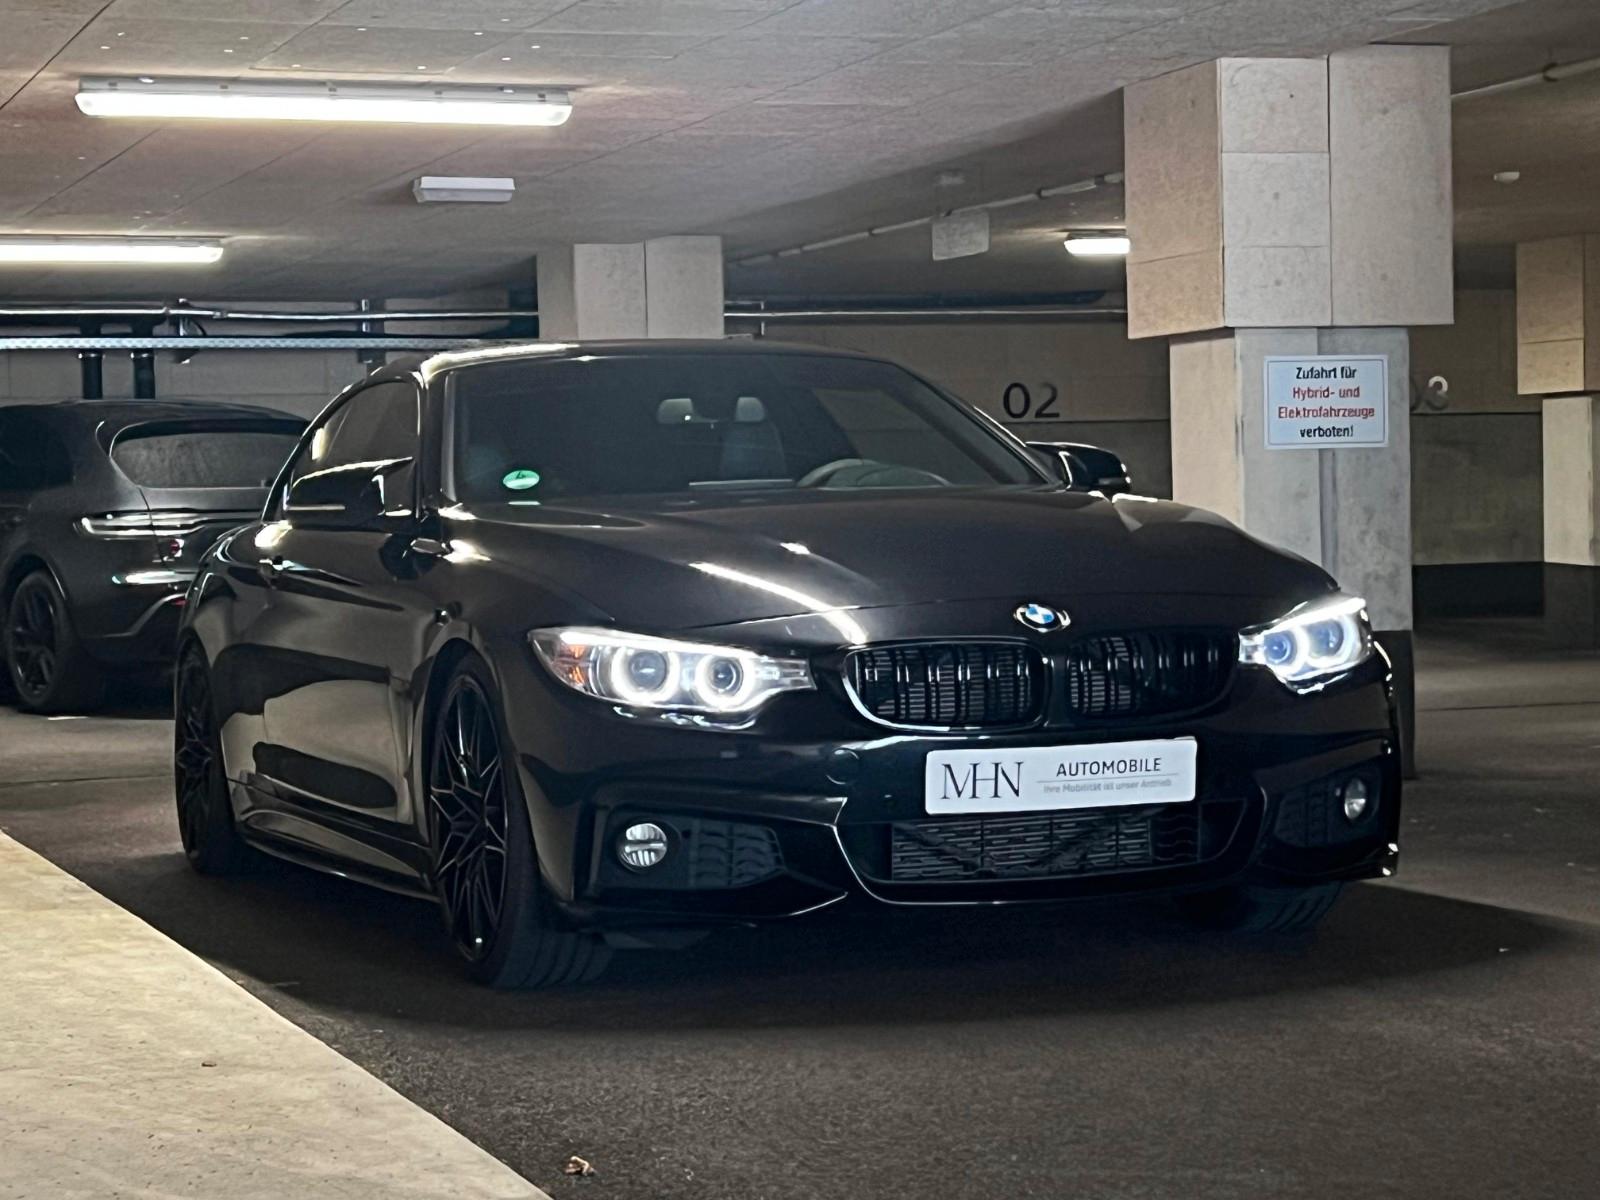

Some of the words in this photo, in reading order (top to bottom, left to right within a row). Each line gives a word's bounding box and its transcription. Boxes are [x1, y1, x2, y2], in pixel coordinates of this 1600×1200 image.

[1296, 366, 1337, 379] Zufahrt
[1341, 366, 1357, 379] für
[1003, 382, 1060, 418] 02
[1292, 386, 1335, 401] Hybrid-
[1339, 386, 1360, 398] und
[1278, 405, 1375, 419] Elektrofahrzeuge
[1300, 424, 1354, 437] verboten!
[1056, 757, 1162, 777] AUTOMOBILE
[941, 761, 1024, 799] MHN
[1116, 782, 1139, 790] unser
